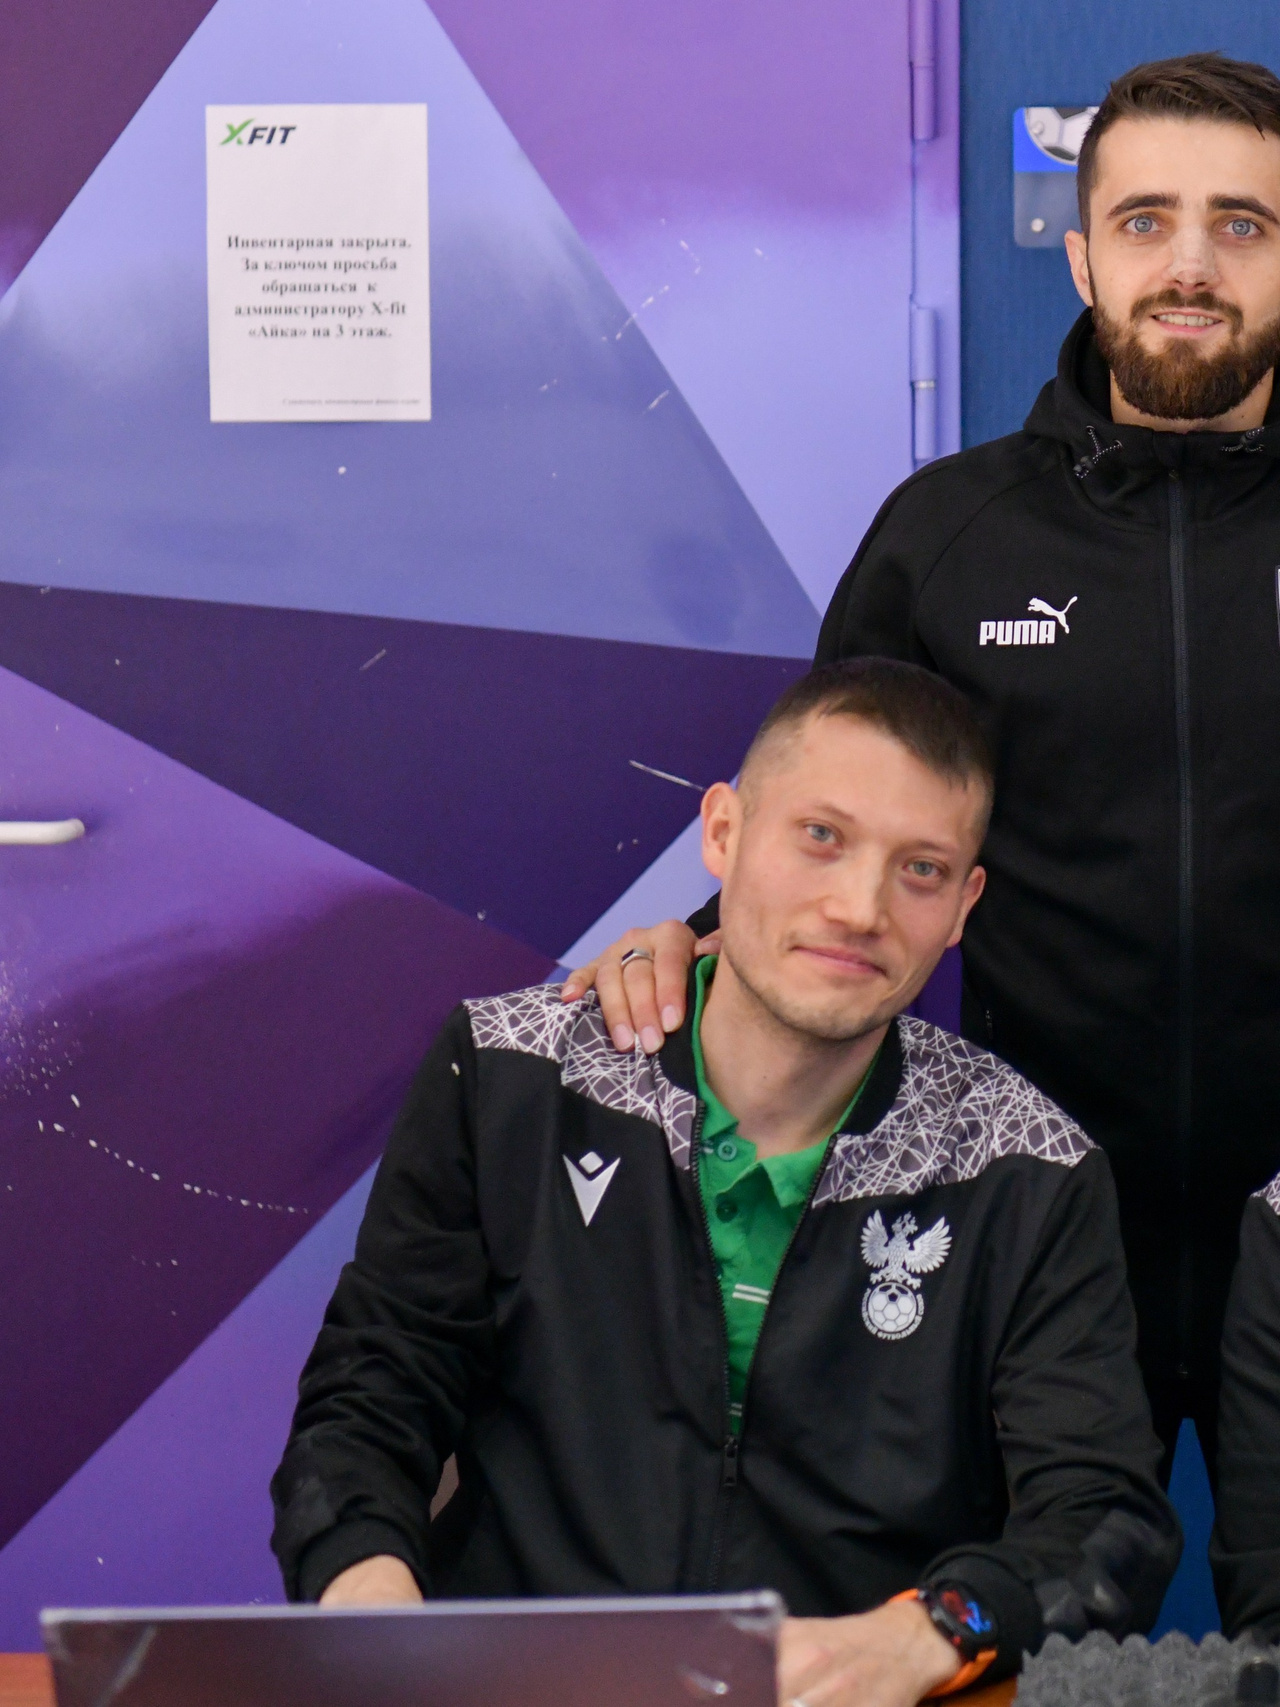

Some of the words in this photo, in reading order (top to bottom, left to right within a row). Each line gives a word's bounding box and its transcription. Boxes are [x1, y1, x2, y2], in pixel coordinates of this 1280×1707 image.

[227, 236, 334, 251] Инвентарная
[341, 237, 412, 251] закрыта.
[243, 257, 260, 272] За
[264, 259, 328, 271] ключом
[333, 257, 398, 273] просьба
[367, 283, 378, 293] к
[234, 305, 366, 319] администратору
[312, 328, 331, 338] на
[335, 325, 345, 338] 3
[979, 620, 1056, 645] PUMA
